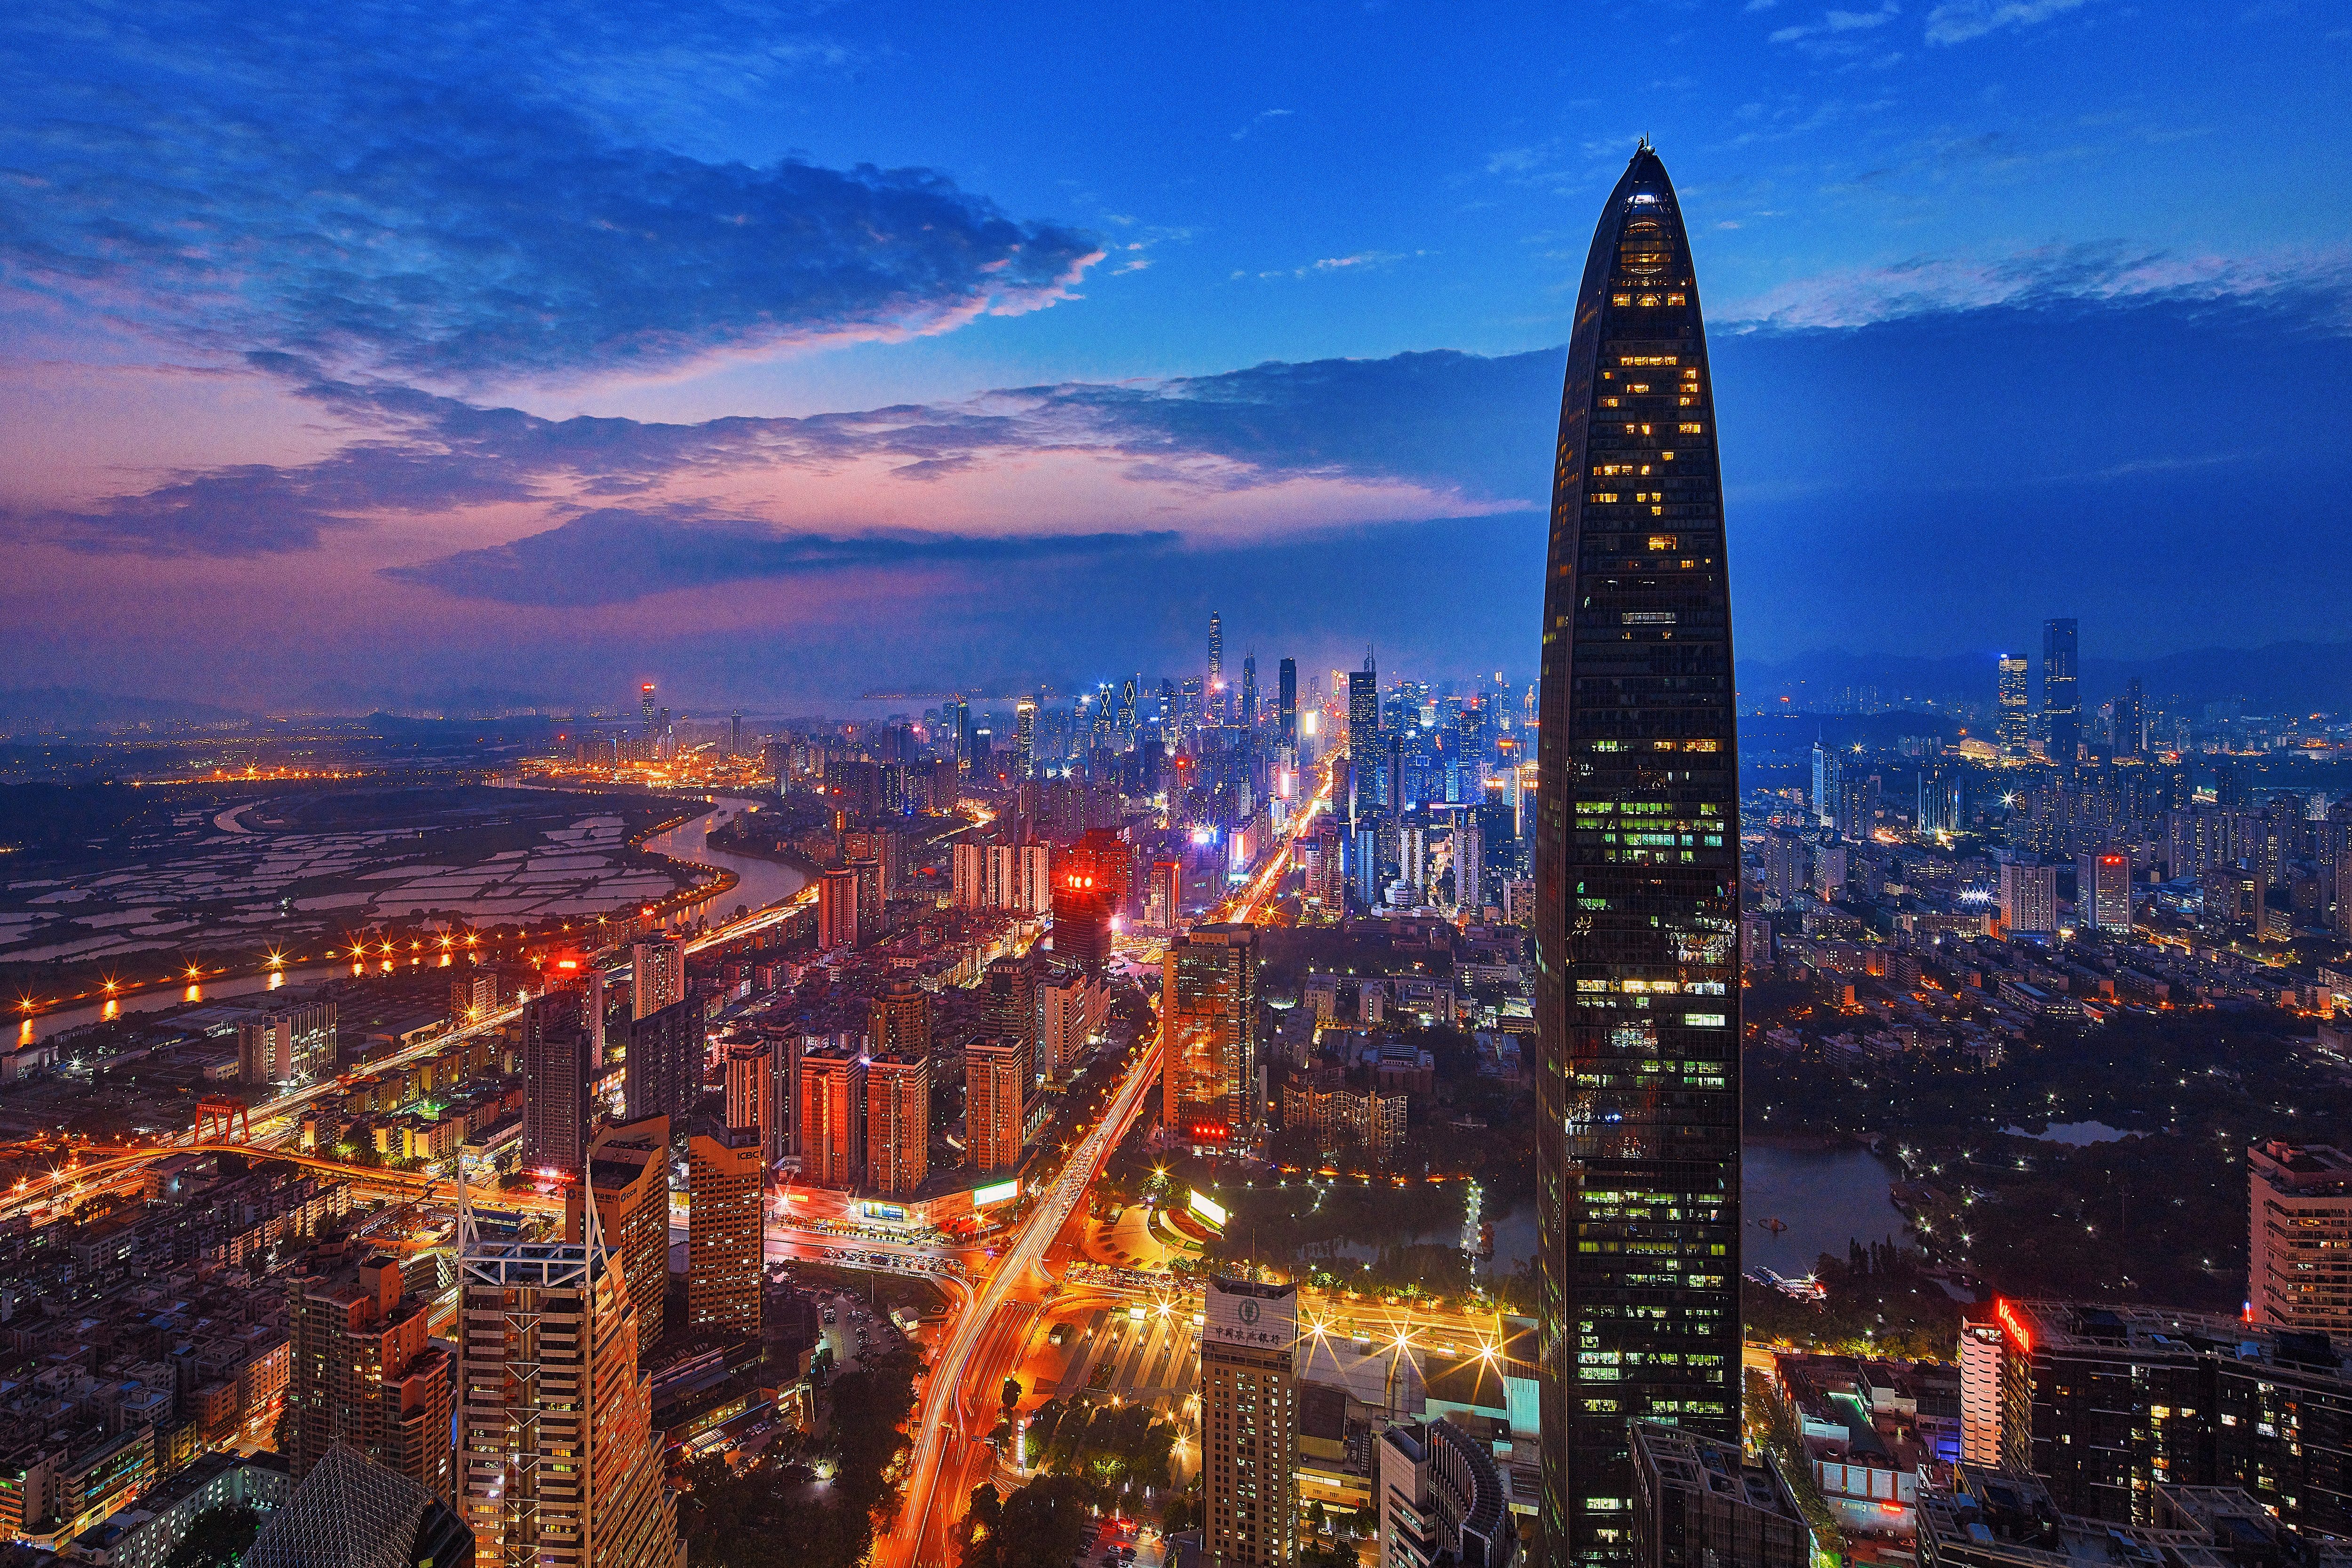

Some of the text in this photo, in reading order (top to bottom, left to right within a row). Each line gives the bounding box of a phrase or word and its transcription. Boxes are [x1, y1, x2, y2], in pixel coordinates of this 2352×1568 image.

[738, 1151, 759, 1160] ICBC
[626, 1188, 637, 1199] CCB
[1999, 1299, 2029, 1352] kkmall
